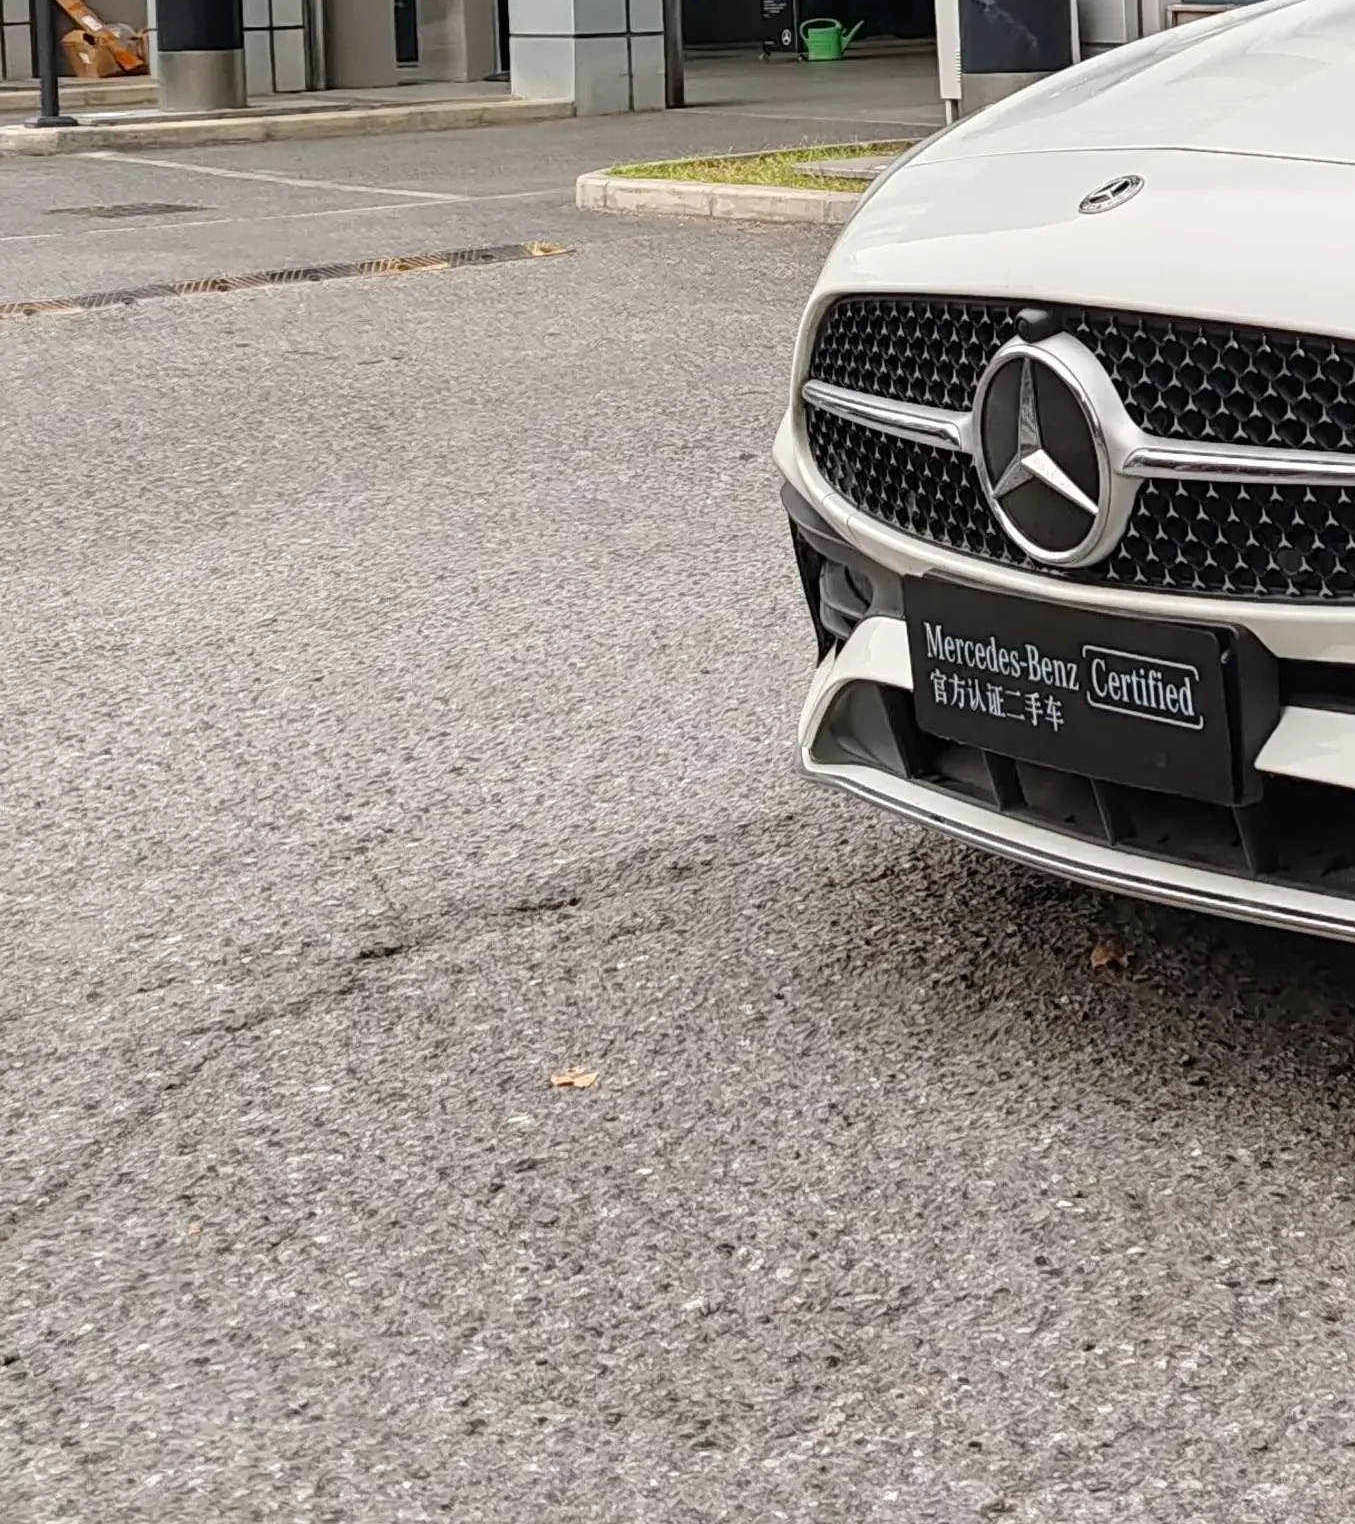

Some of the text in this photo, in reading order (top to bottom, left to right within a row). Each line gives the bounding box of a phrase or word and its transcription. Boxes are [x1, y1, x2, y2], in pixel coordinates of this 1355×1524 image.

[923, 622, 1195, 717] Mercedes-Benz Certified
[930, 667, 1065, 732] 官方认证二手车
